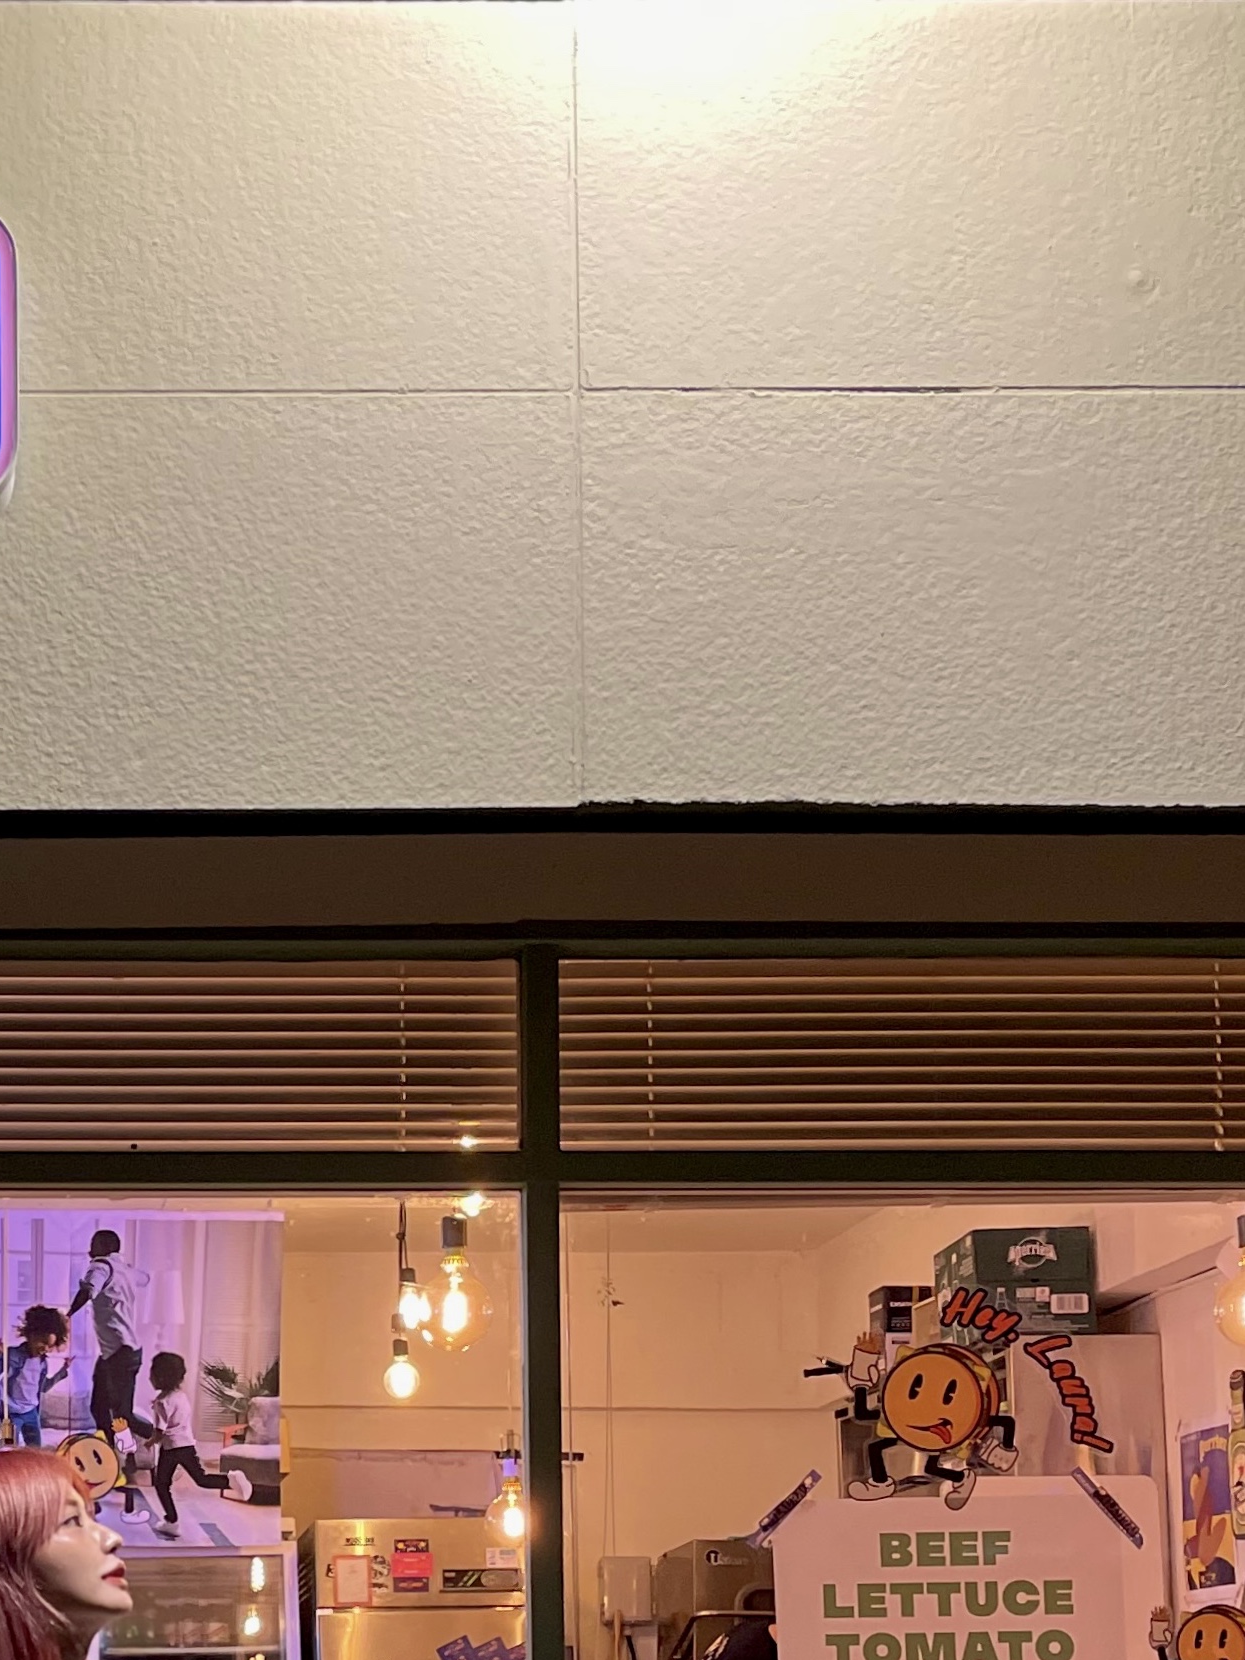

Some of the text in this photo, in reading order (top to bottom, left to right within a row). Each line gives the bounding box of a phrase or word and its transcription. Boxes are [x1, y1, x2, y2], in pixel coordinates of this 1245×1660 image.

[940, 1286, 1022, 1343] Hey,
[1023, 1334, 1113, 1454] Laura!
[879, 1530, 1011, 1568] BEEF
[822, 1579, 1074, 1619] LETTUCE
